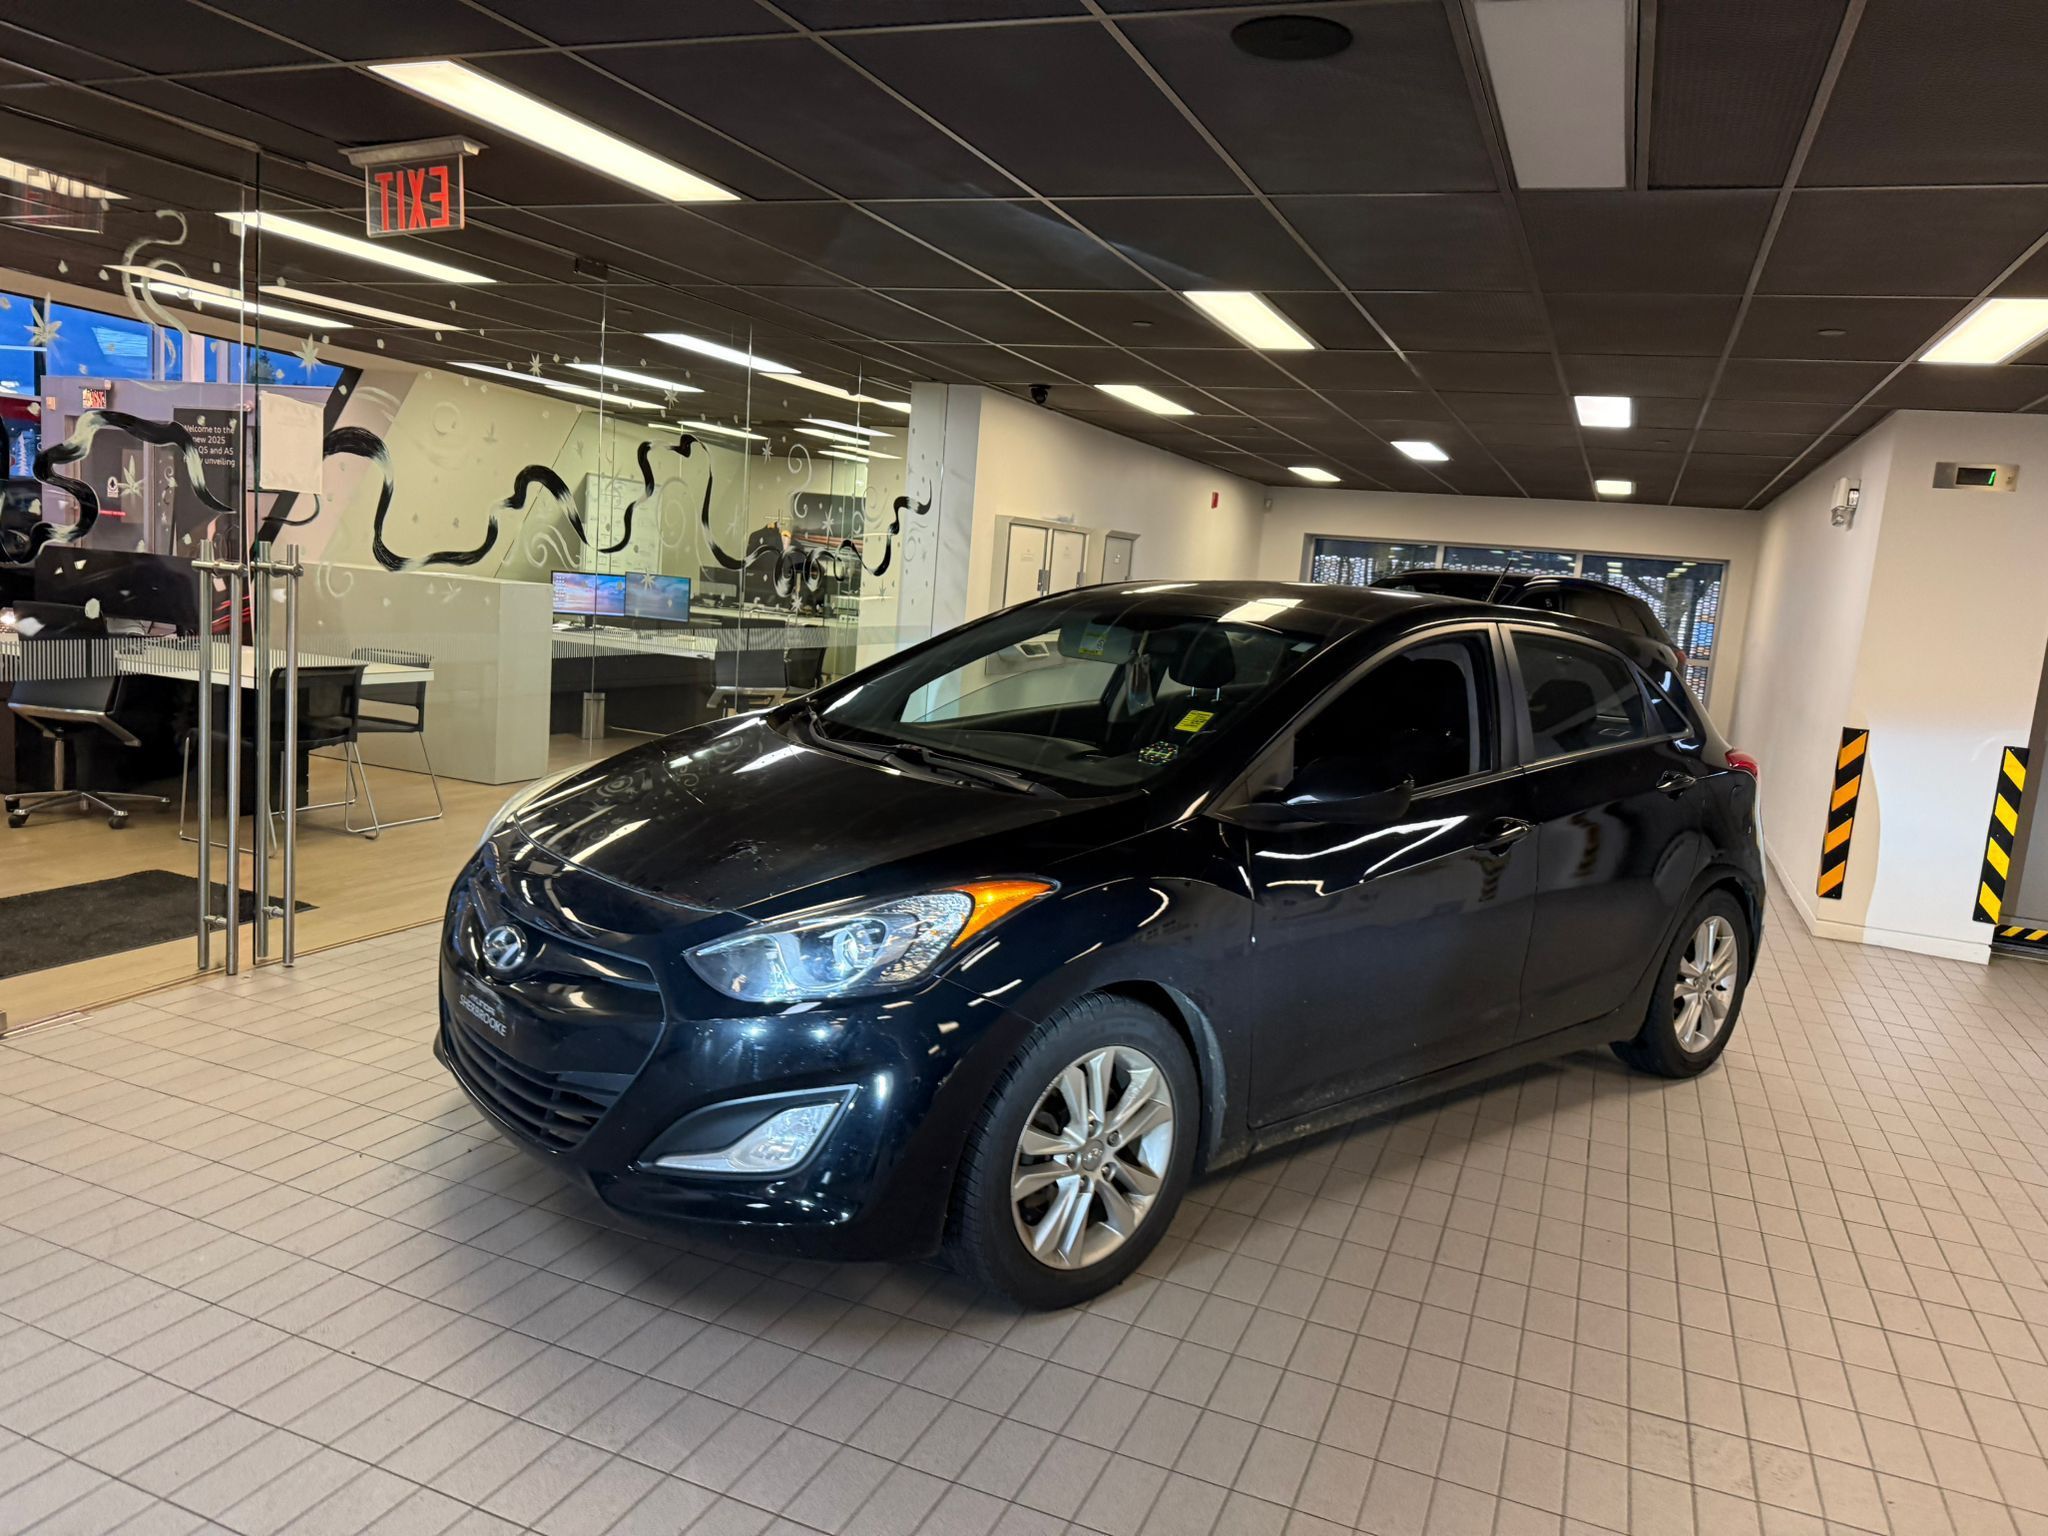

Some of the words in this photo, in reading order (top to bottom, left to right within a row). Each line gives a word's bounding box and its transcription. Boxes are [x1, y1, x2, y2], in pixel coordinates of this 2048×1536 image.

[214, 426, 221, 434] to
[223, 425, 235, 434] the
[208, 436, 226, 444] 2025
[209, 446, 222, 454] and
[204, 457, 235, 467] unveiling
[459, 994, 507, 1037] SHERBROOKE
